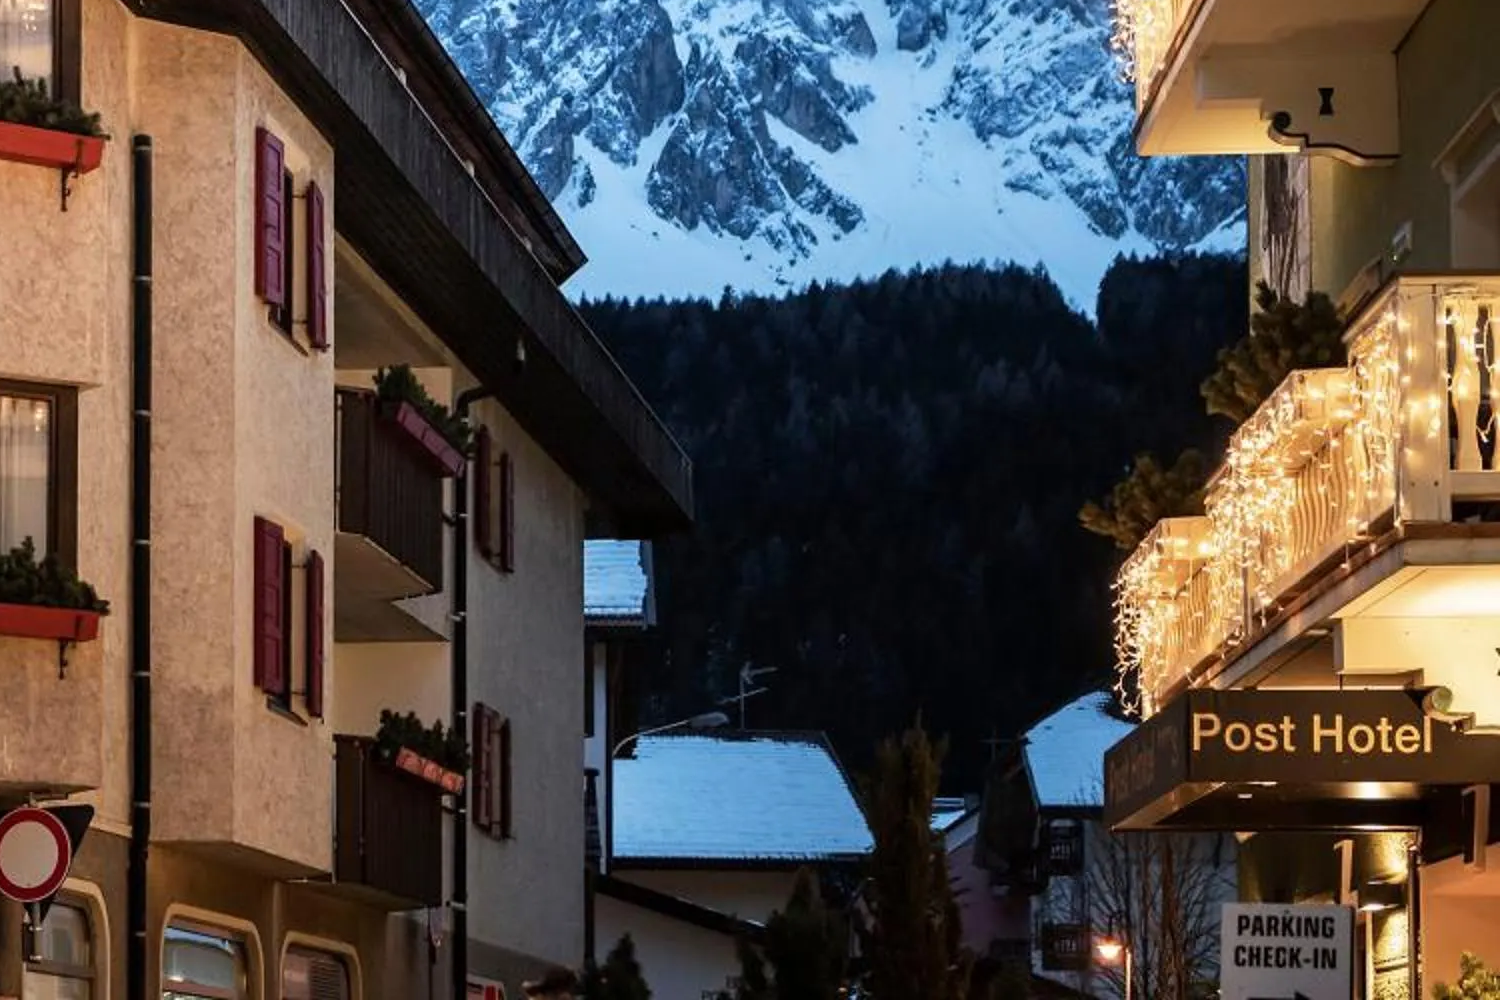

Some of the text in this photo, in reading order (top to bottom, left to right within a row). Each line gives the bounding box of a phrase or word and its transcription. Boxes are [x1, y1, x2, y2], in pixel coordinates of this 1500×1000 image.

[1191, 712, 1434, 754] Post Hotel
[1236, 914, 1336, 940] PARKING
[1233, 944, 1338, 970] CHECK-IN
